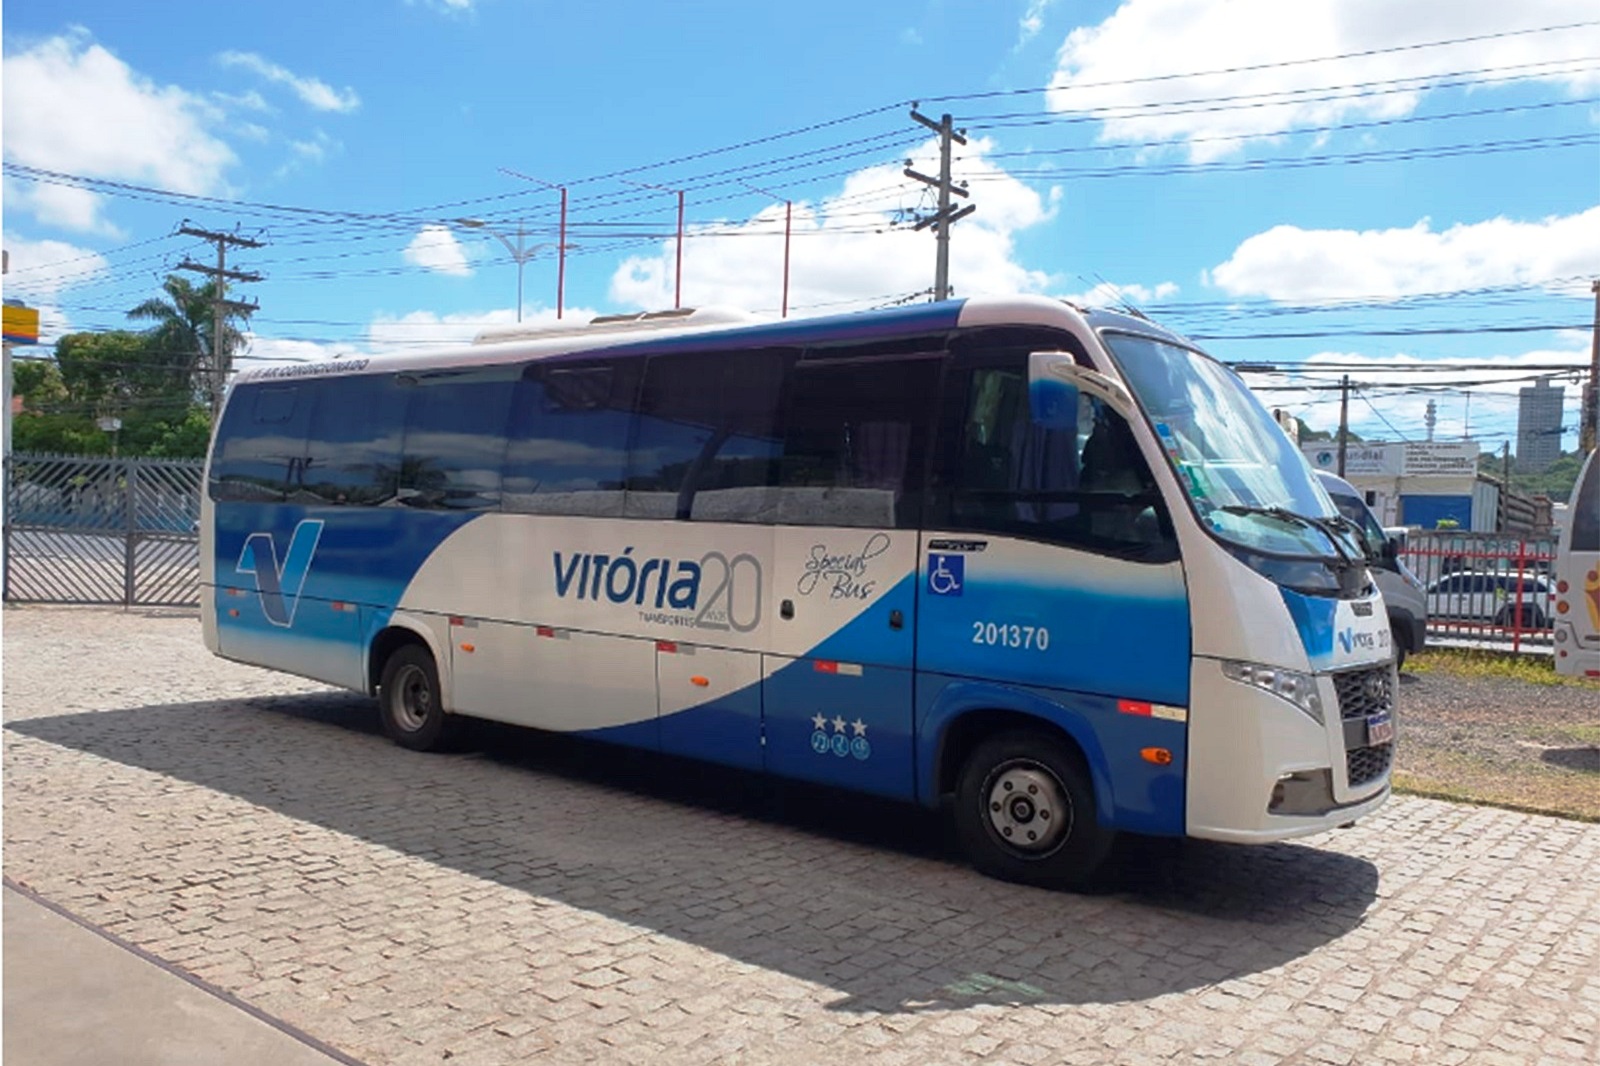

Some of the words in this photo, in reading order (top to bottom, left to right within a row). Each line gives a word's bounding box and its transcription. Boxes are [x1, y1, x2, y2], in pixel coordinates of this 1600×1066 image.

[797, 533, 891, 596] Special
[823, 570, 876, 600] Bus
[972, 621, 1049, 651] 201370
